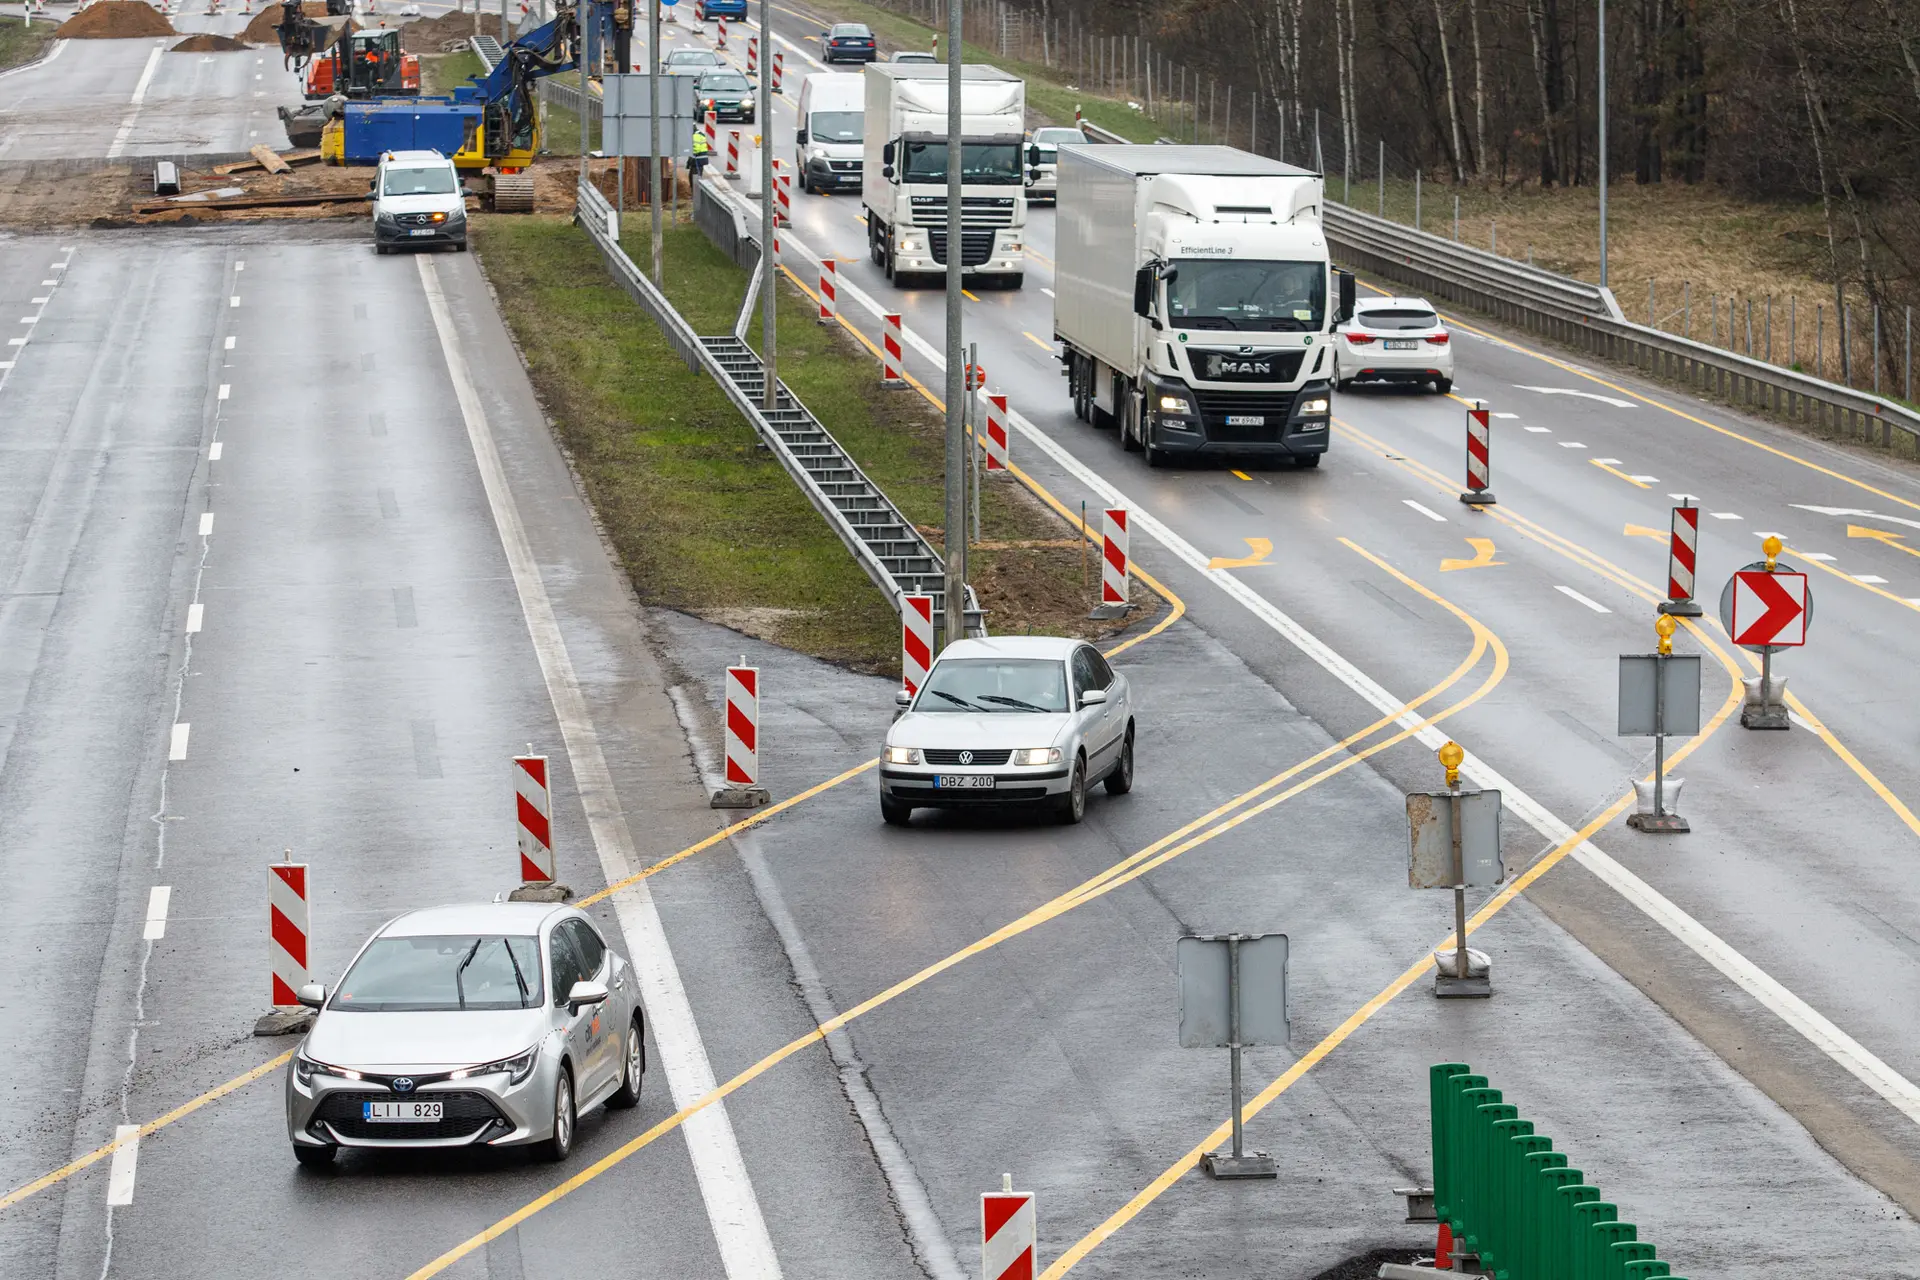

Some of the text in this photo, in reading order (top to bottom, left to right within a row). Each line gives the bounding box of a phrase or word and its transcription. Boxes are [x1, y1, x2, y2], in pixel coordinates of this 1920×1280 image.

[1180, 246, 1233, 255] EfficientLine 3
[1221, 362, 1270, 374] MAN
[941, 776, 992, 787] DBZ 200
[372, 1104, 441, 1117] LII 829
